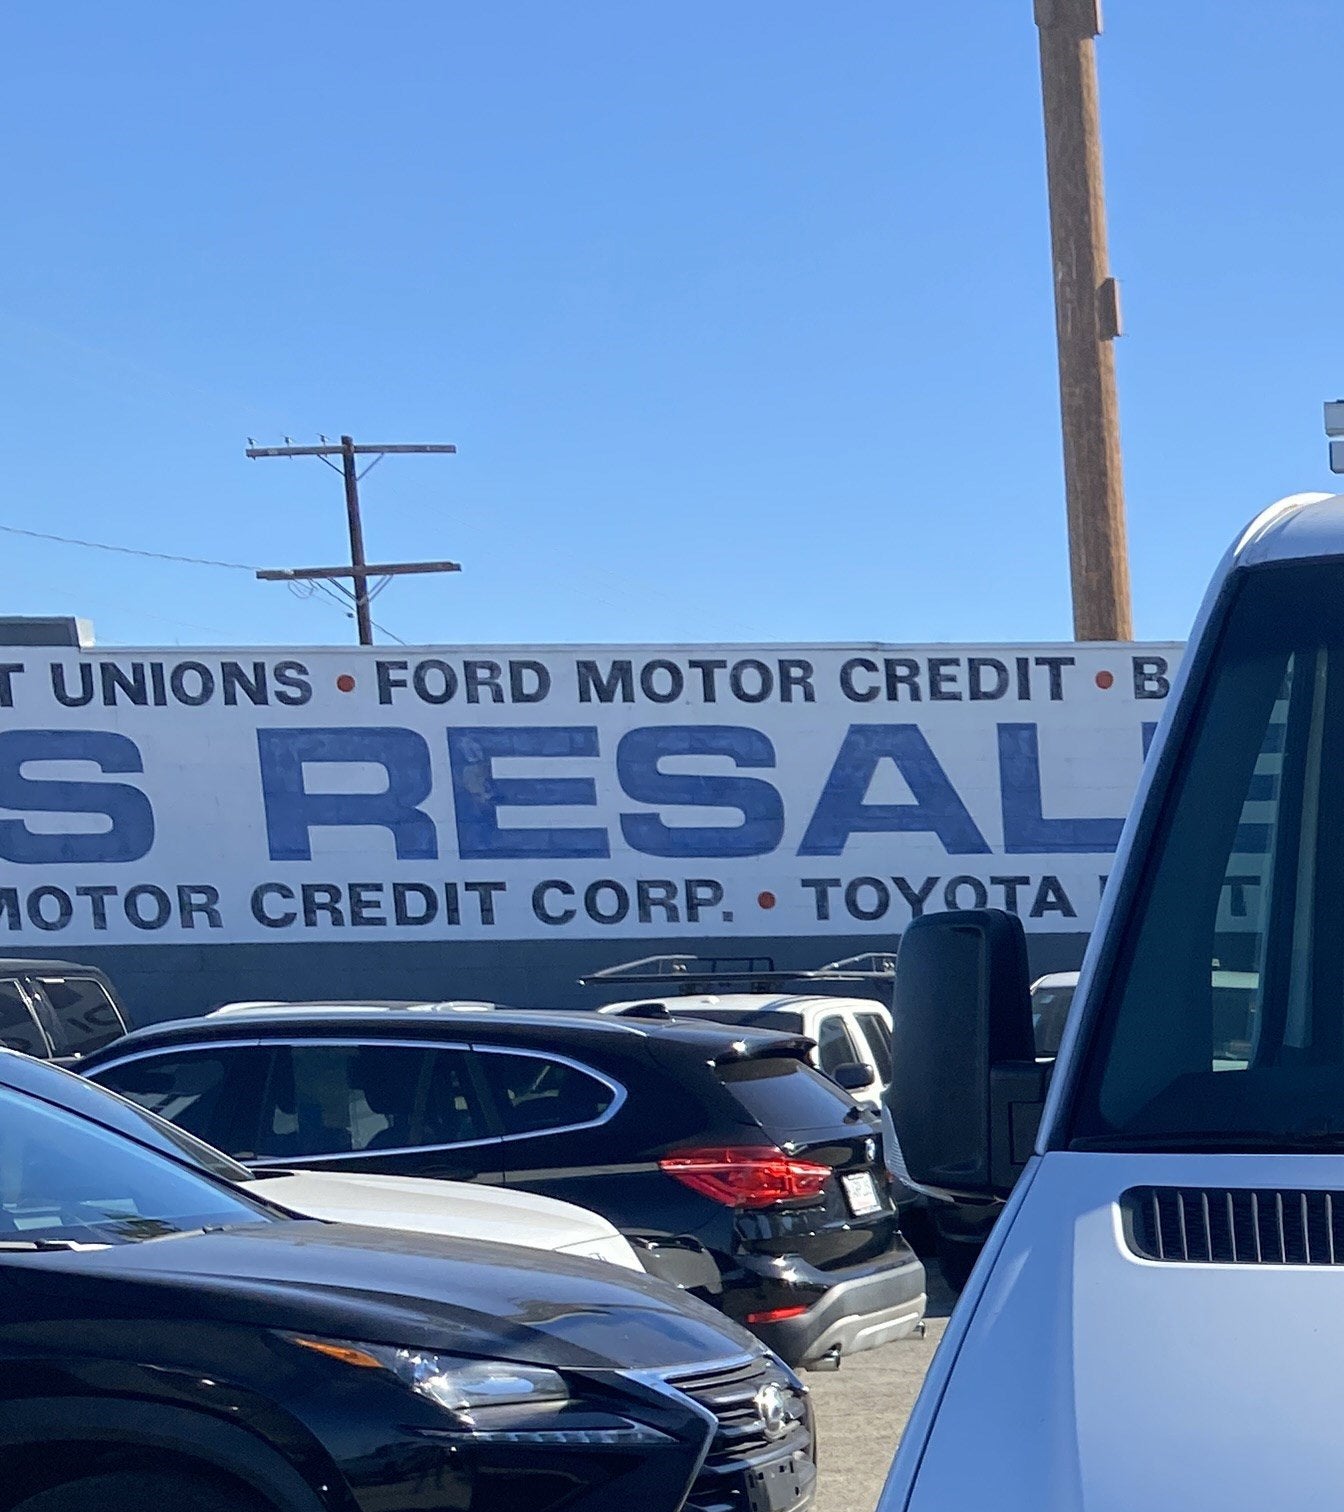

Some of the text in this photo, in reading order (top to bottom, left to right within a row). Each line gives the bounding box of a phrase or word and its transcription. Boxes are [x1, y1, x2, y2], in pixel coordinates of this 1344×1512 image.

[50, 659, 313, 707] UNIONS
[375, 659, 551, 705] FORD
[577, 657, 817, 704] MOTOR
[839, 656, 1075, 702] CREDIT
[256, 722, 1158, 862] RESAL
[250, 880, 506, 928] CREDIT
[532, 878, 734, 926] CORP.
[800, 875, 1078, 921] TOYOTA
